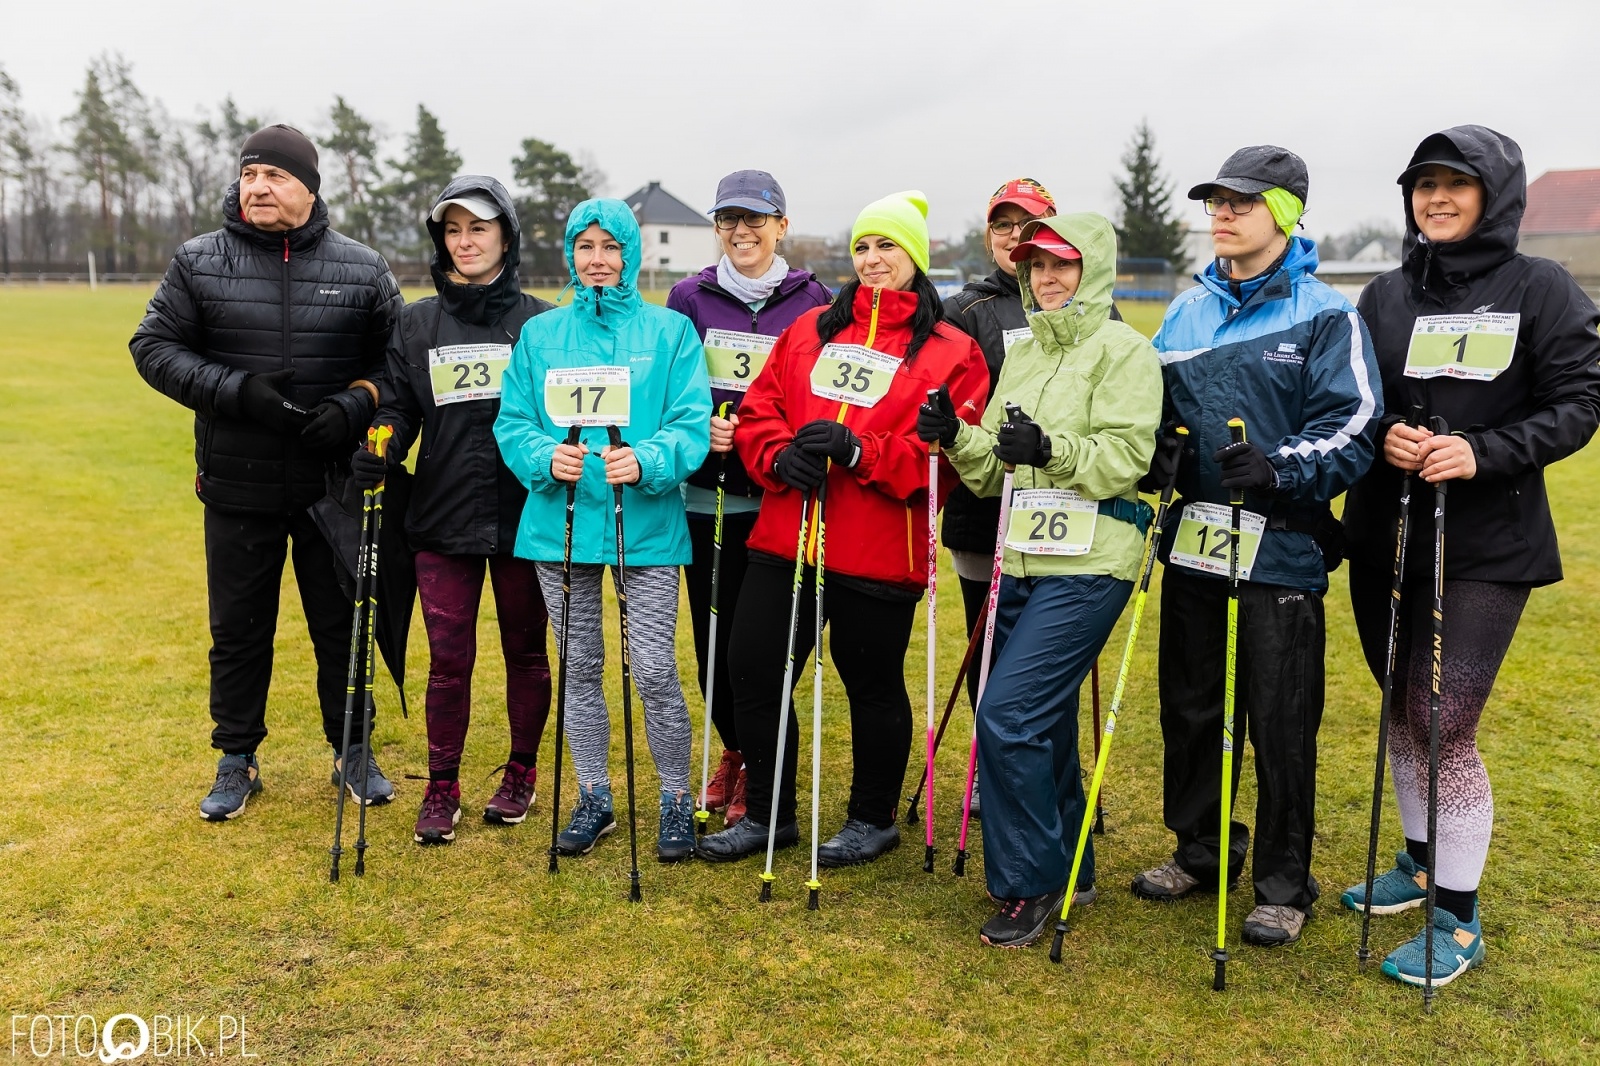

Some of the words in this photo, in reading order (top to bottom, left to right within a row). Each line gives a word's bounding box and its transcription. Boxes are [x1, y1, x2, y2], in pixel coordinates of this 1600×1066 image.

[1452, 333, 1468, 363] 1
[453, 362, 491, 390] 23
[733, 352, 751, 379] 3
[832, 362, 874, 393] 35
[570, 386, 607, 413] 17
[1029, 510, 1069, 541] 26
[1196, 524, 1233, 560] 12
[370, 542, 379, 577] LEKI
[1432, 632, 1443, 695] FIZAN
